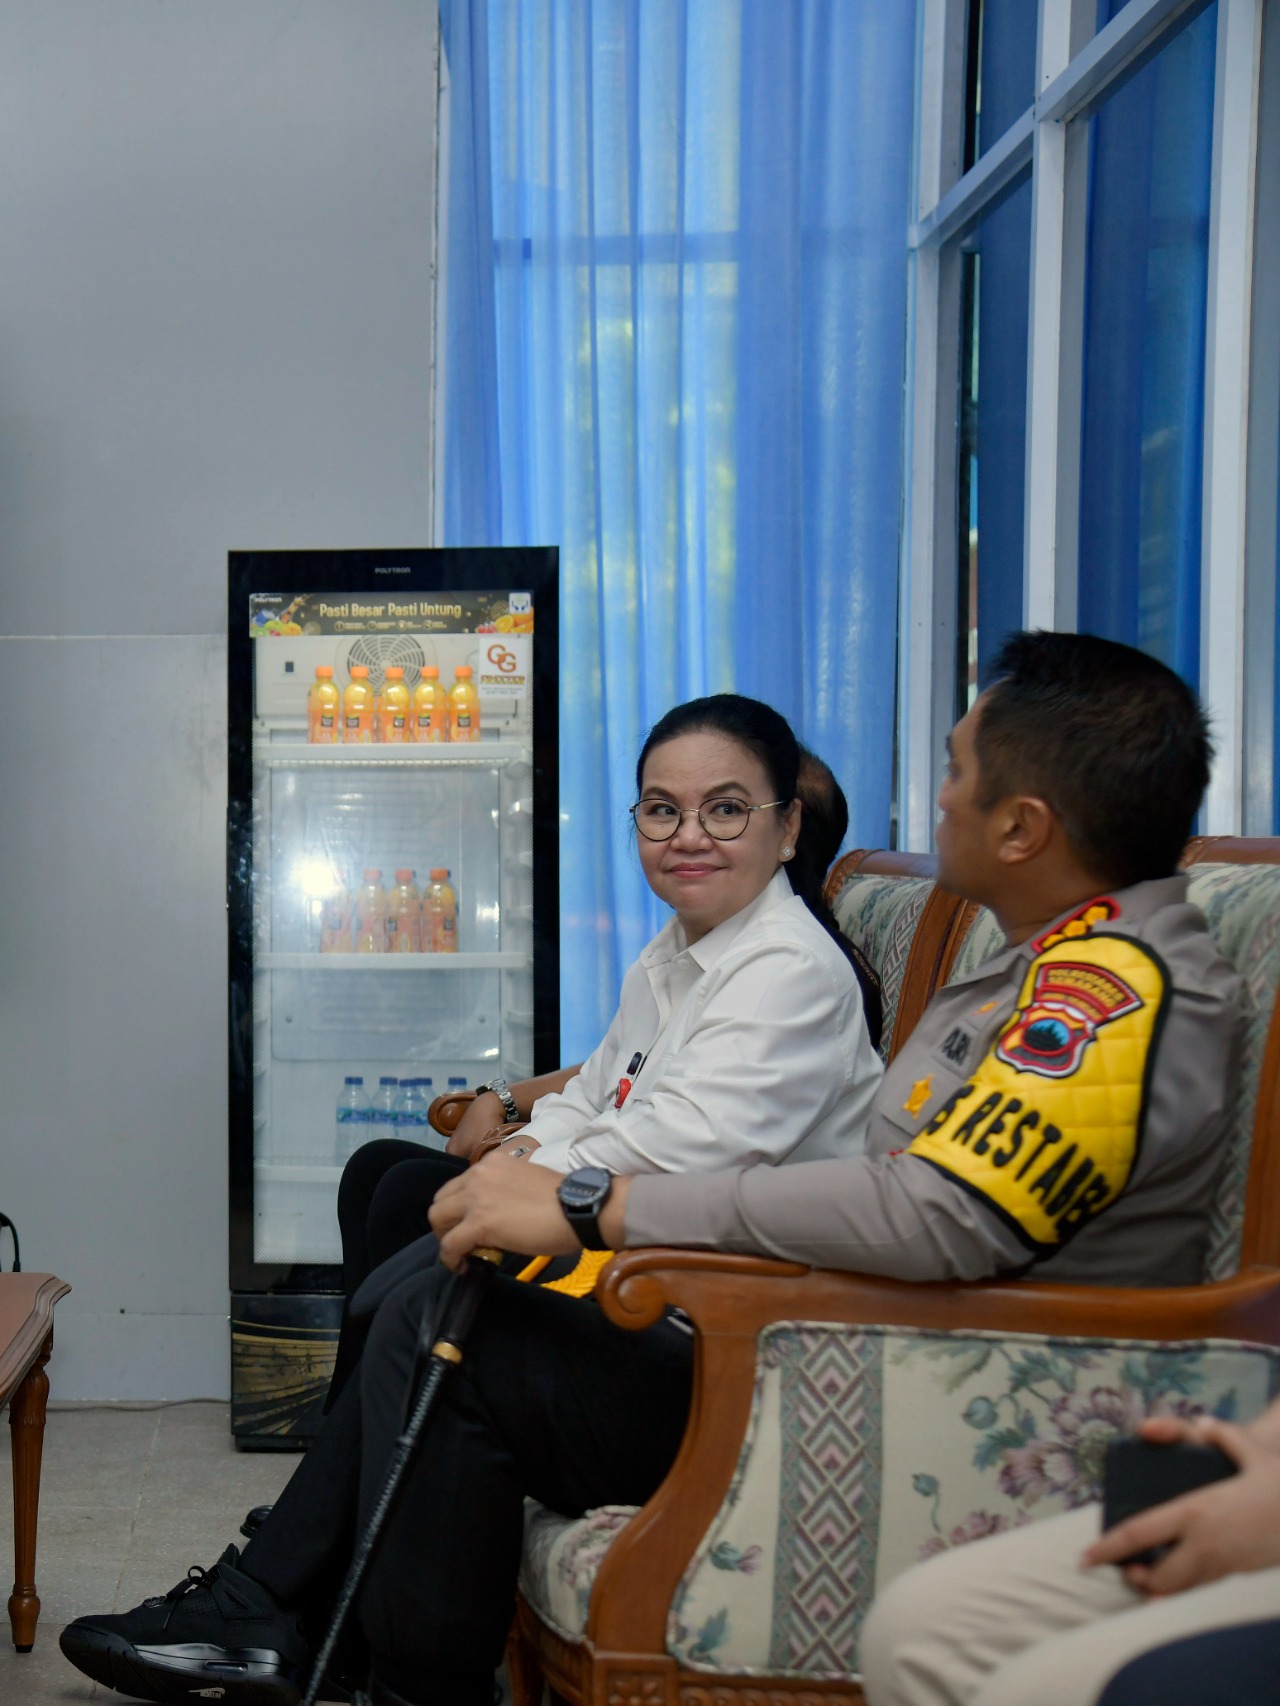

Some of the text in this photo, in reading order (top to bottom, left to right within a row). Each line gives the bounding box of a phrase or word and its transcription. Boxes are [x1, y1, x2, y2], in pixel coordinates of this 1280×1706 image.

[320, 602, 462, 618] Pasti Besar Pasti Untung
